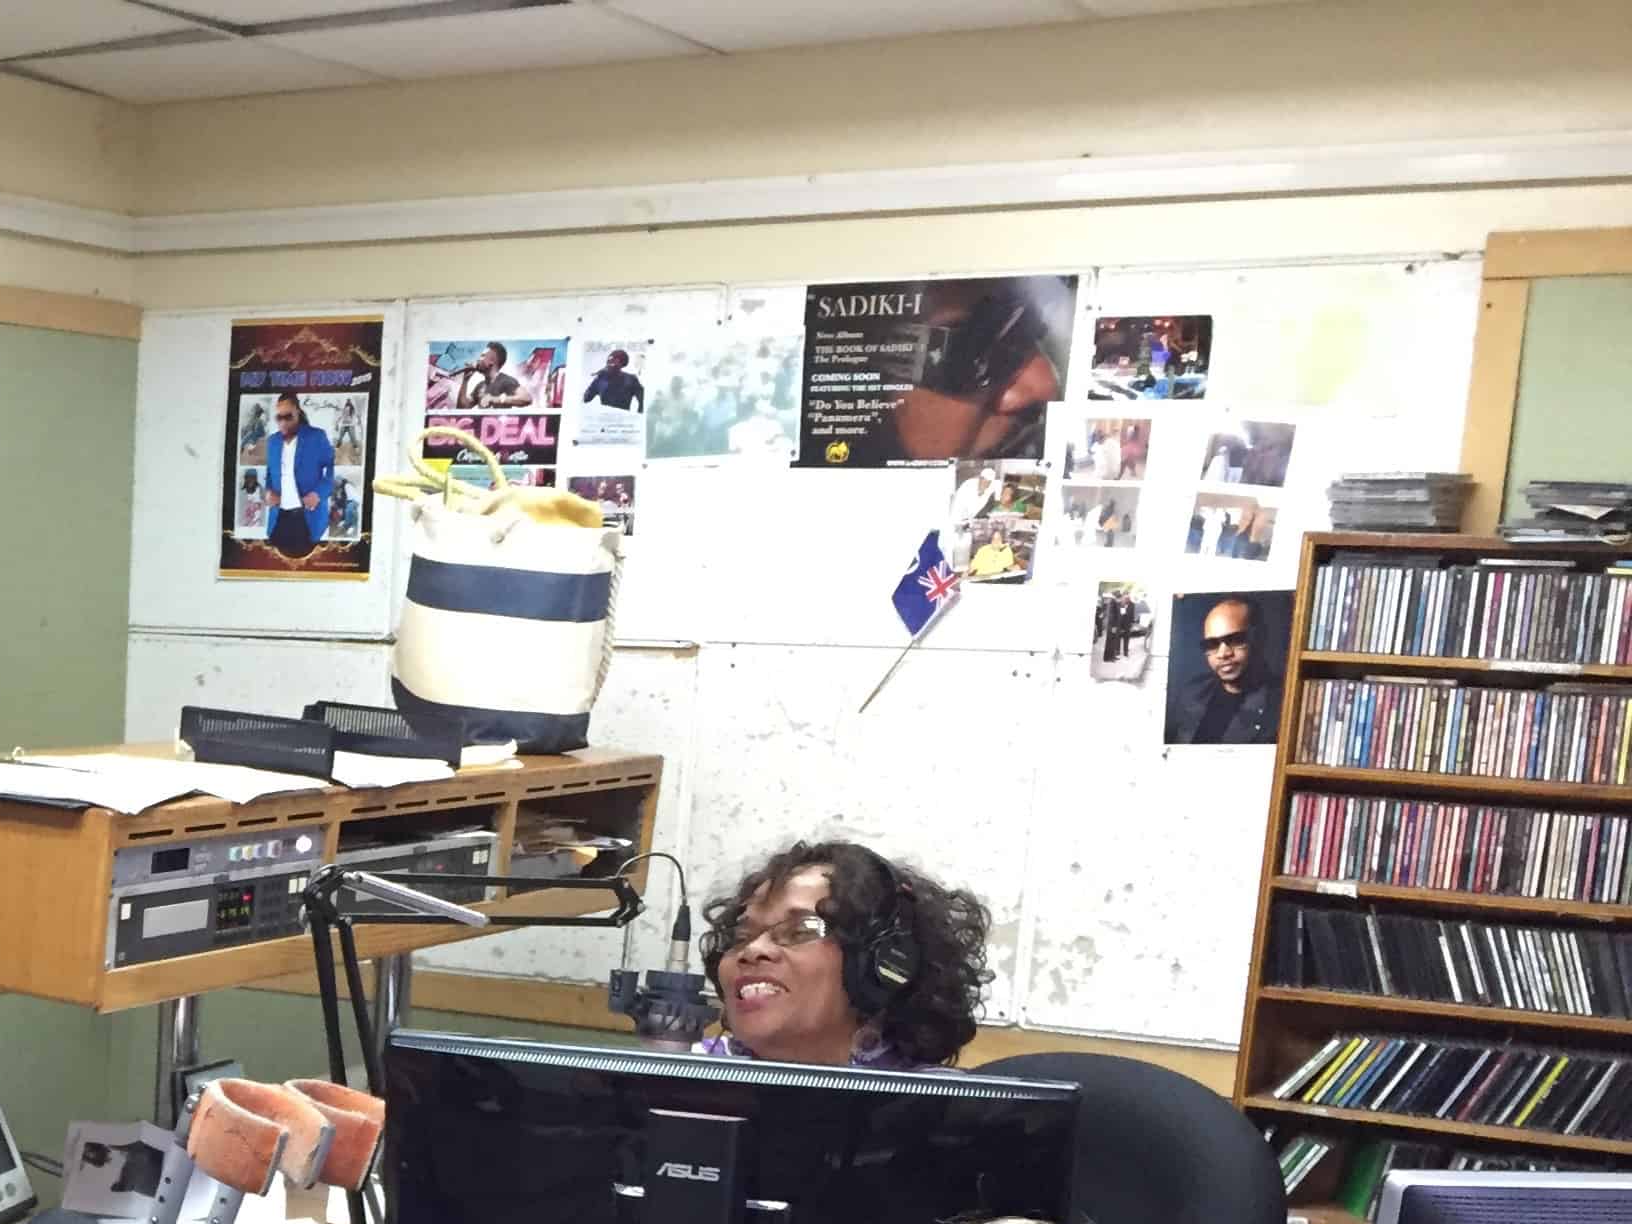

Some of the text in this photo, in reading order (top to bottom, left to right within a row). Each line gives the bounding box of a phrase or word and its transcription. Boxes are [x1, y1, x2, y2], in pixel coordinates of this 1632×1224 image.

[836, 344, 864, 354] BOOK
[810, 372, 881, 383] COMING SOON
[835, 399, 854, 410] You
[481, 415, 555, 447] DEAL
[811, 424, 833, 435] and
[656, 1162, 720, 1182] ASUS
